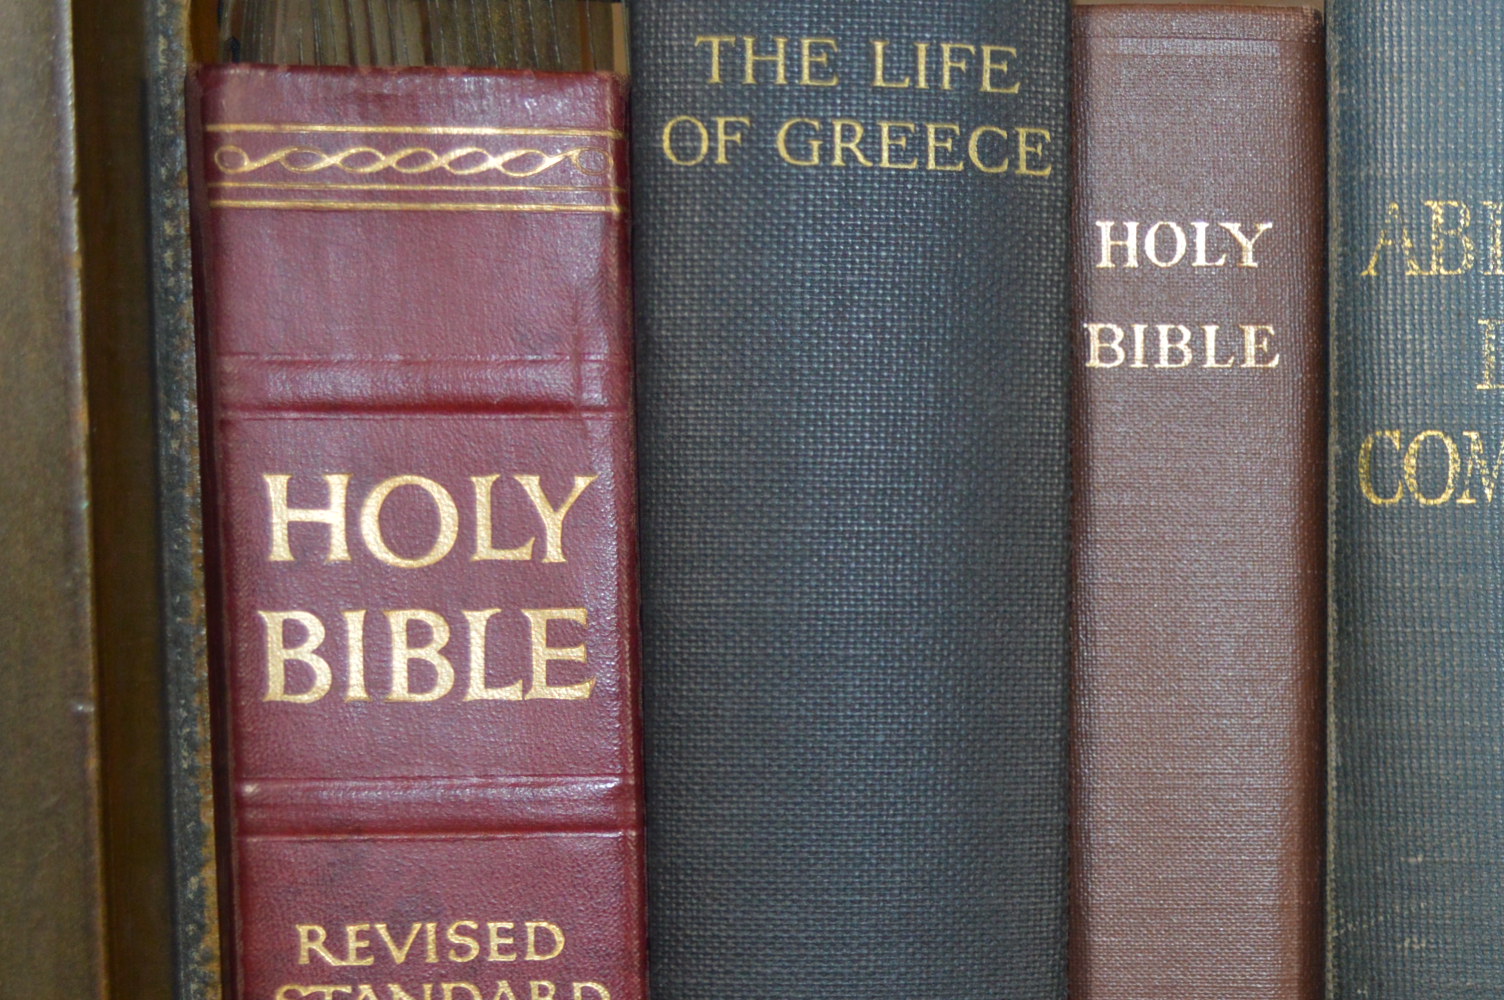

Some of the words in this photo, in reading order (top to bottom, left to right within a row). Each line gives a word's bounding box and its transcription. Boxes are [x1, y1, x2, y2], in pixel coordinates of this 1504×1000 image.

[695, 35, 840, 90] THE
[868, 39, 1023, 96] LIFE
[661, 115, 752, 168] OF
[776, 118, 1055, 178] GREECE
[1095, 220, 1274, 270] HOLY
[1084, 321, 1282, 370] BIBLE
[263, 472, 600, 569] HOLY
[257, 608, 597, 703] BIBLE
[295, 920, 566, 967] REVISED
